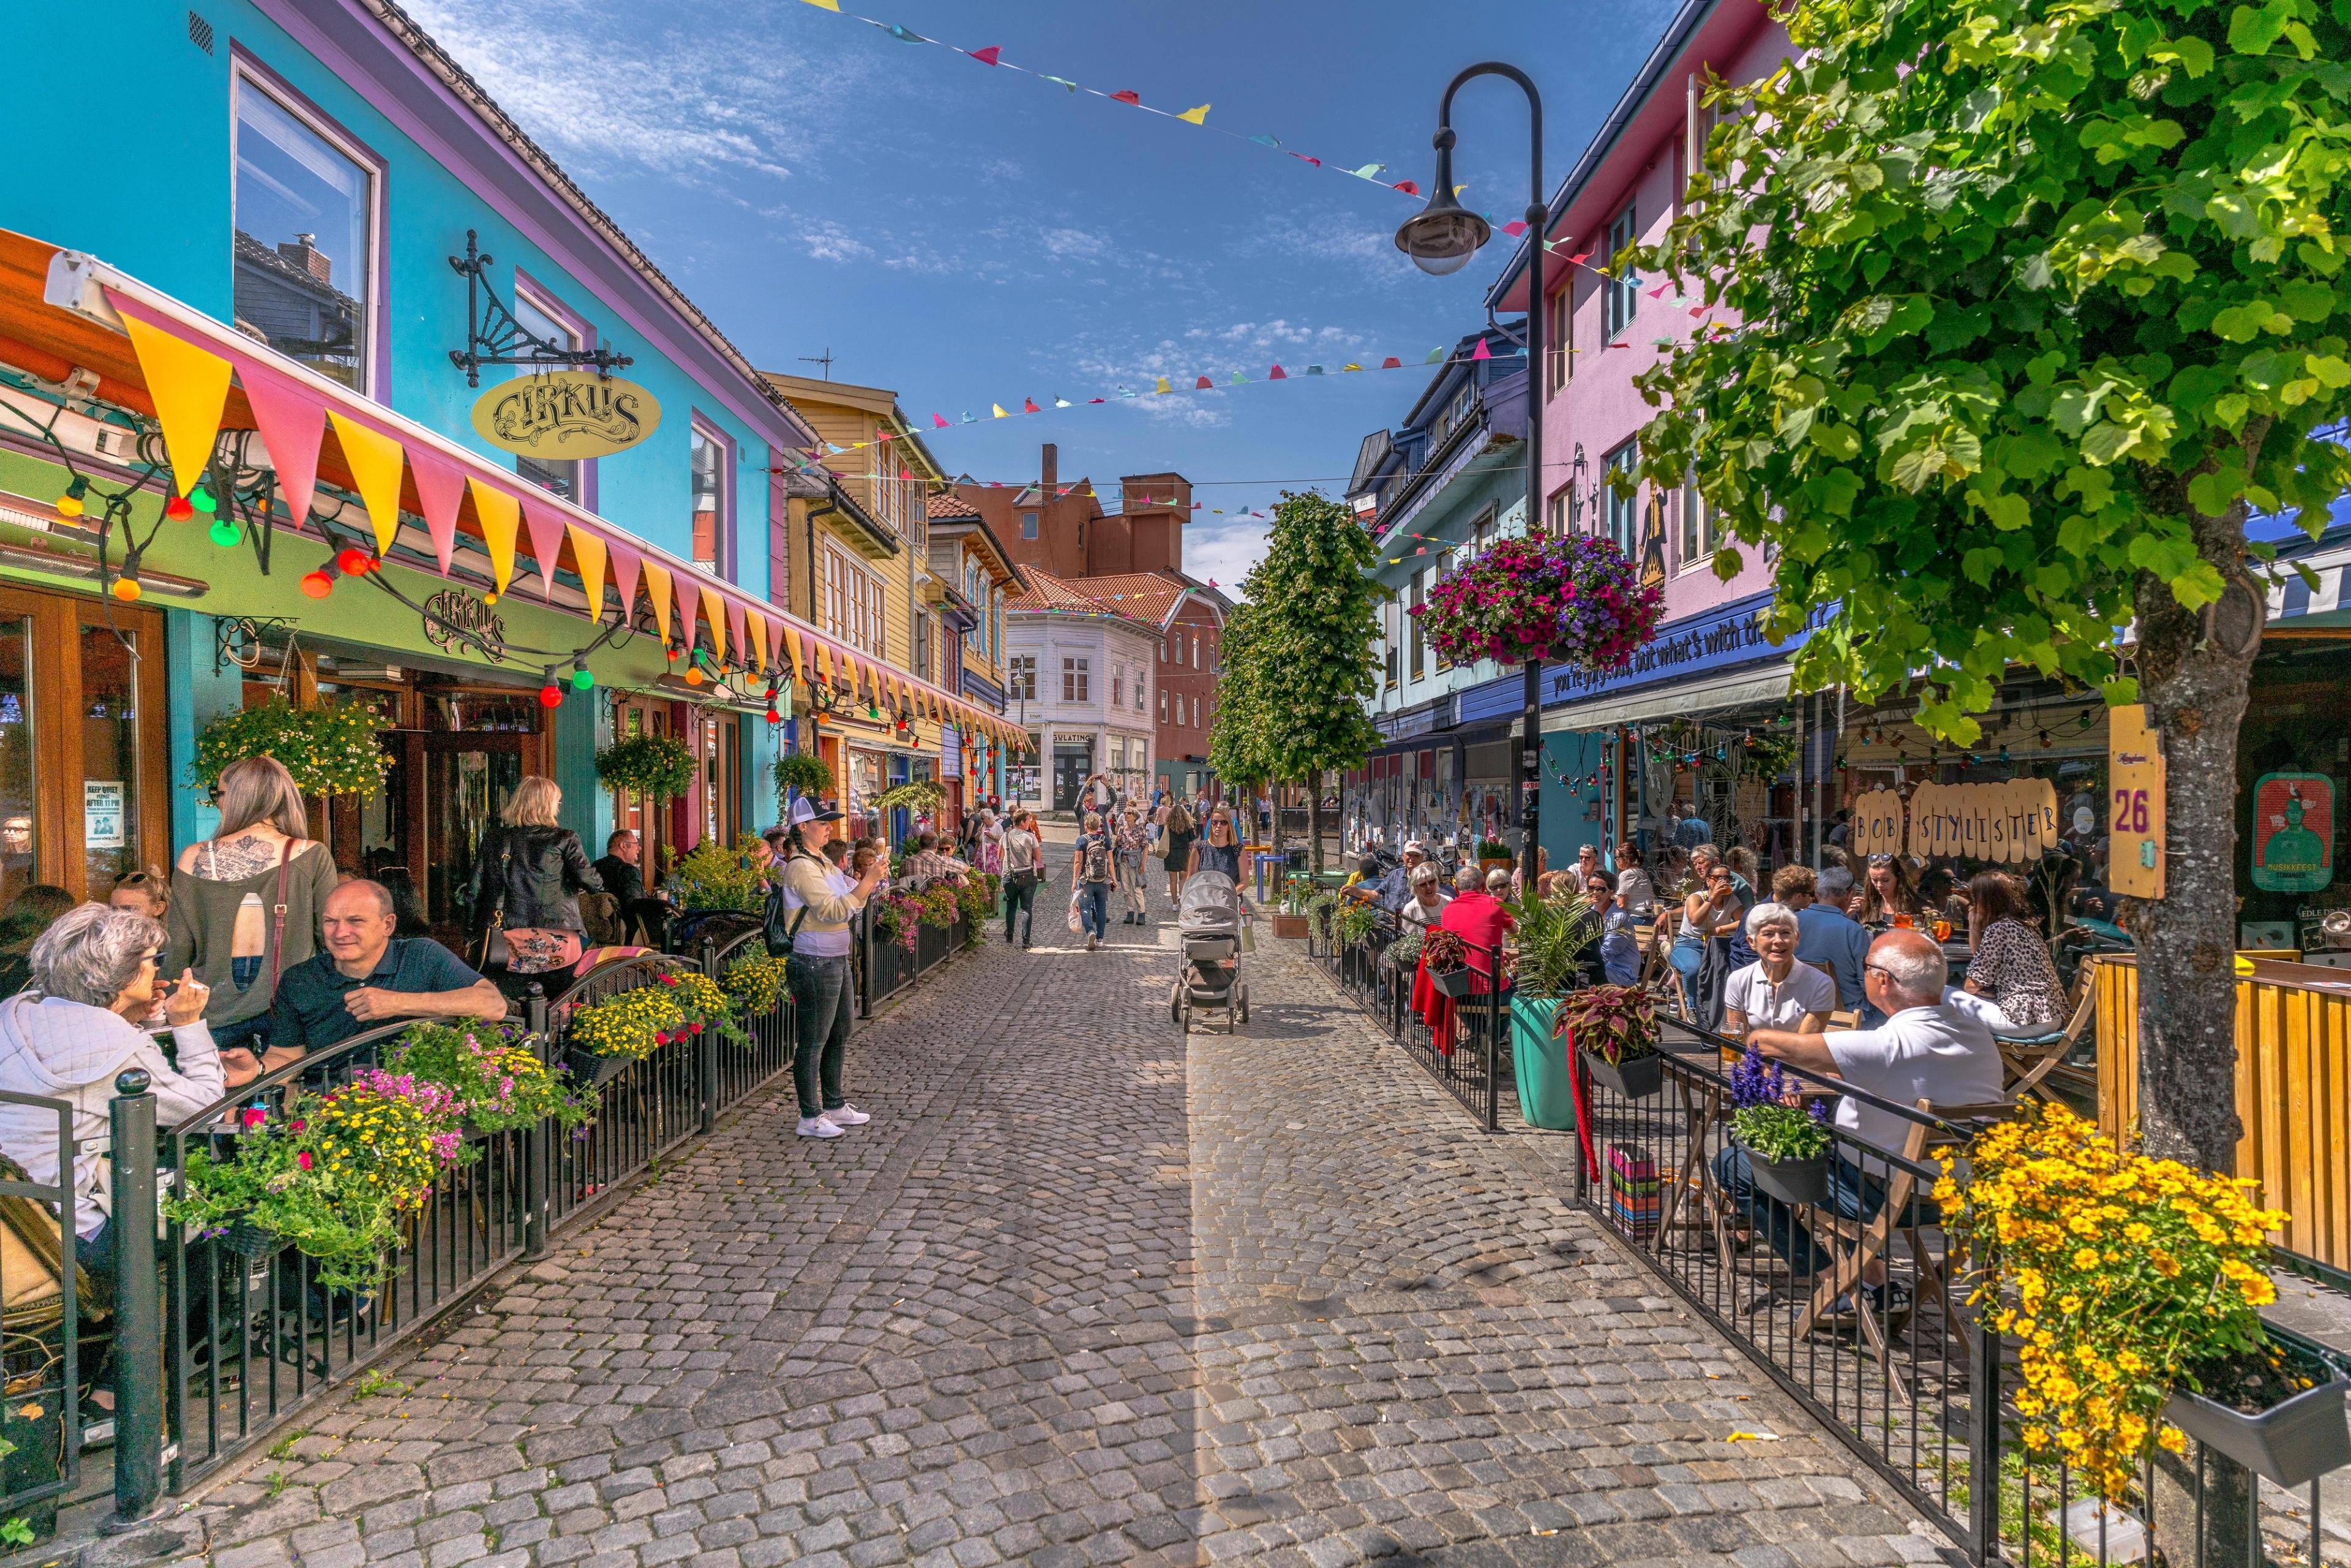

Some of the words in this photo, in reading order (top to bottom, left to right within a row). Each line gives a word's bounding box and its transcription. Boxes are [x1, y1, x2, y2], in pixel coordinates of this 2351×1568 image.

[493, 378, 640, 447] CIRKUS
[425, 589, 506, 664] CIRKUS
[1635, 645, 1655, 674] but
[1657, 629, 1702, 667] what's
[1703, 618, 1740, 654] with
[1858, 816, 1895, 839] BOB
[1921, 807, 2057, 842] STYLISTER
[2115, 789, 2150, 833] 26
[2302, 909, 2322, 918] EDLE
